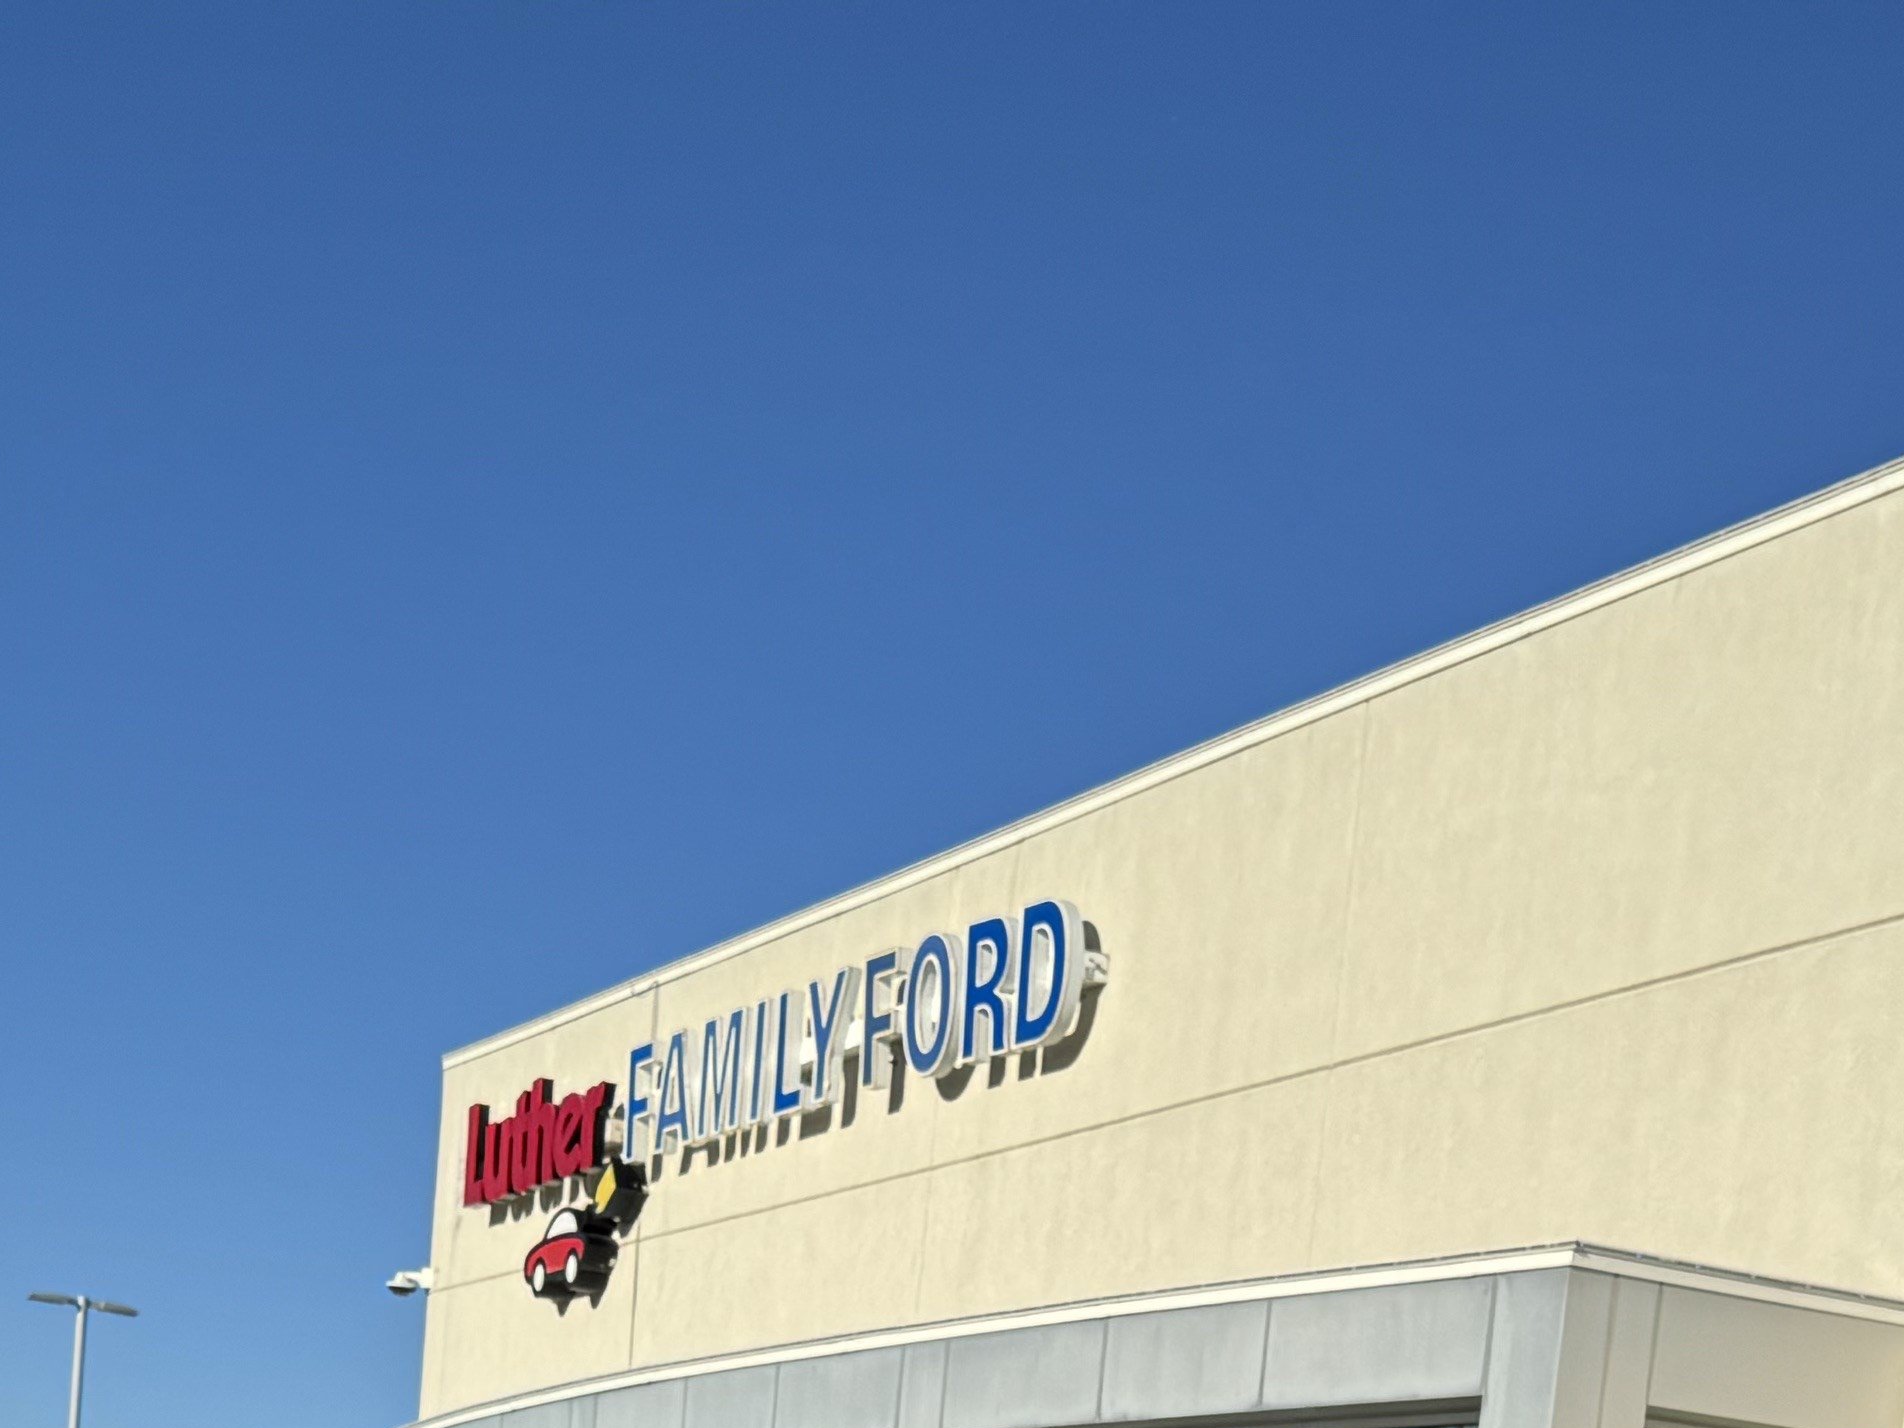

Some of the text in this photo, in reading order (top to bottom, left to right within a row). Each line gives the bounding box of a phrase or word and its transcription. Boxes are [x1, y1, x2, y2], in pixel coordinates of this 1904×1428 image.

[464, 898, 1077, 1207] Luther FAMILY FORD
